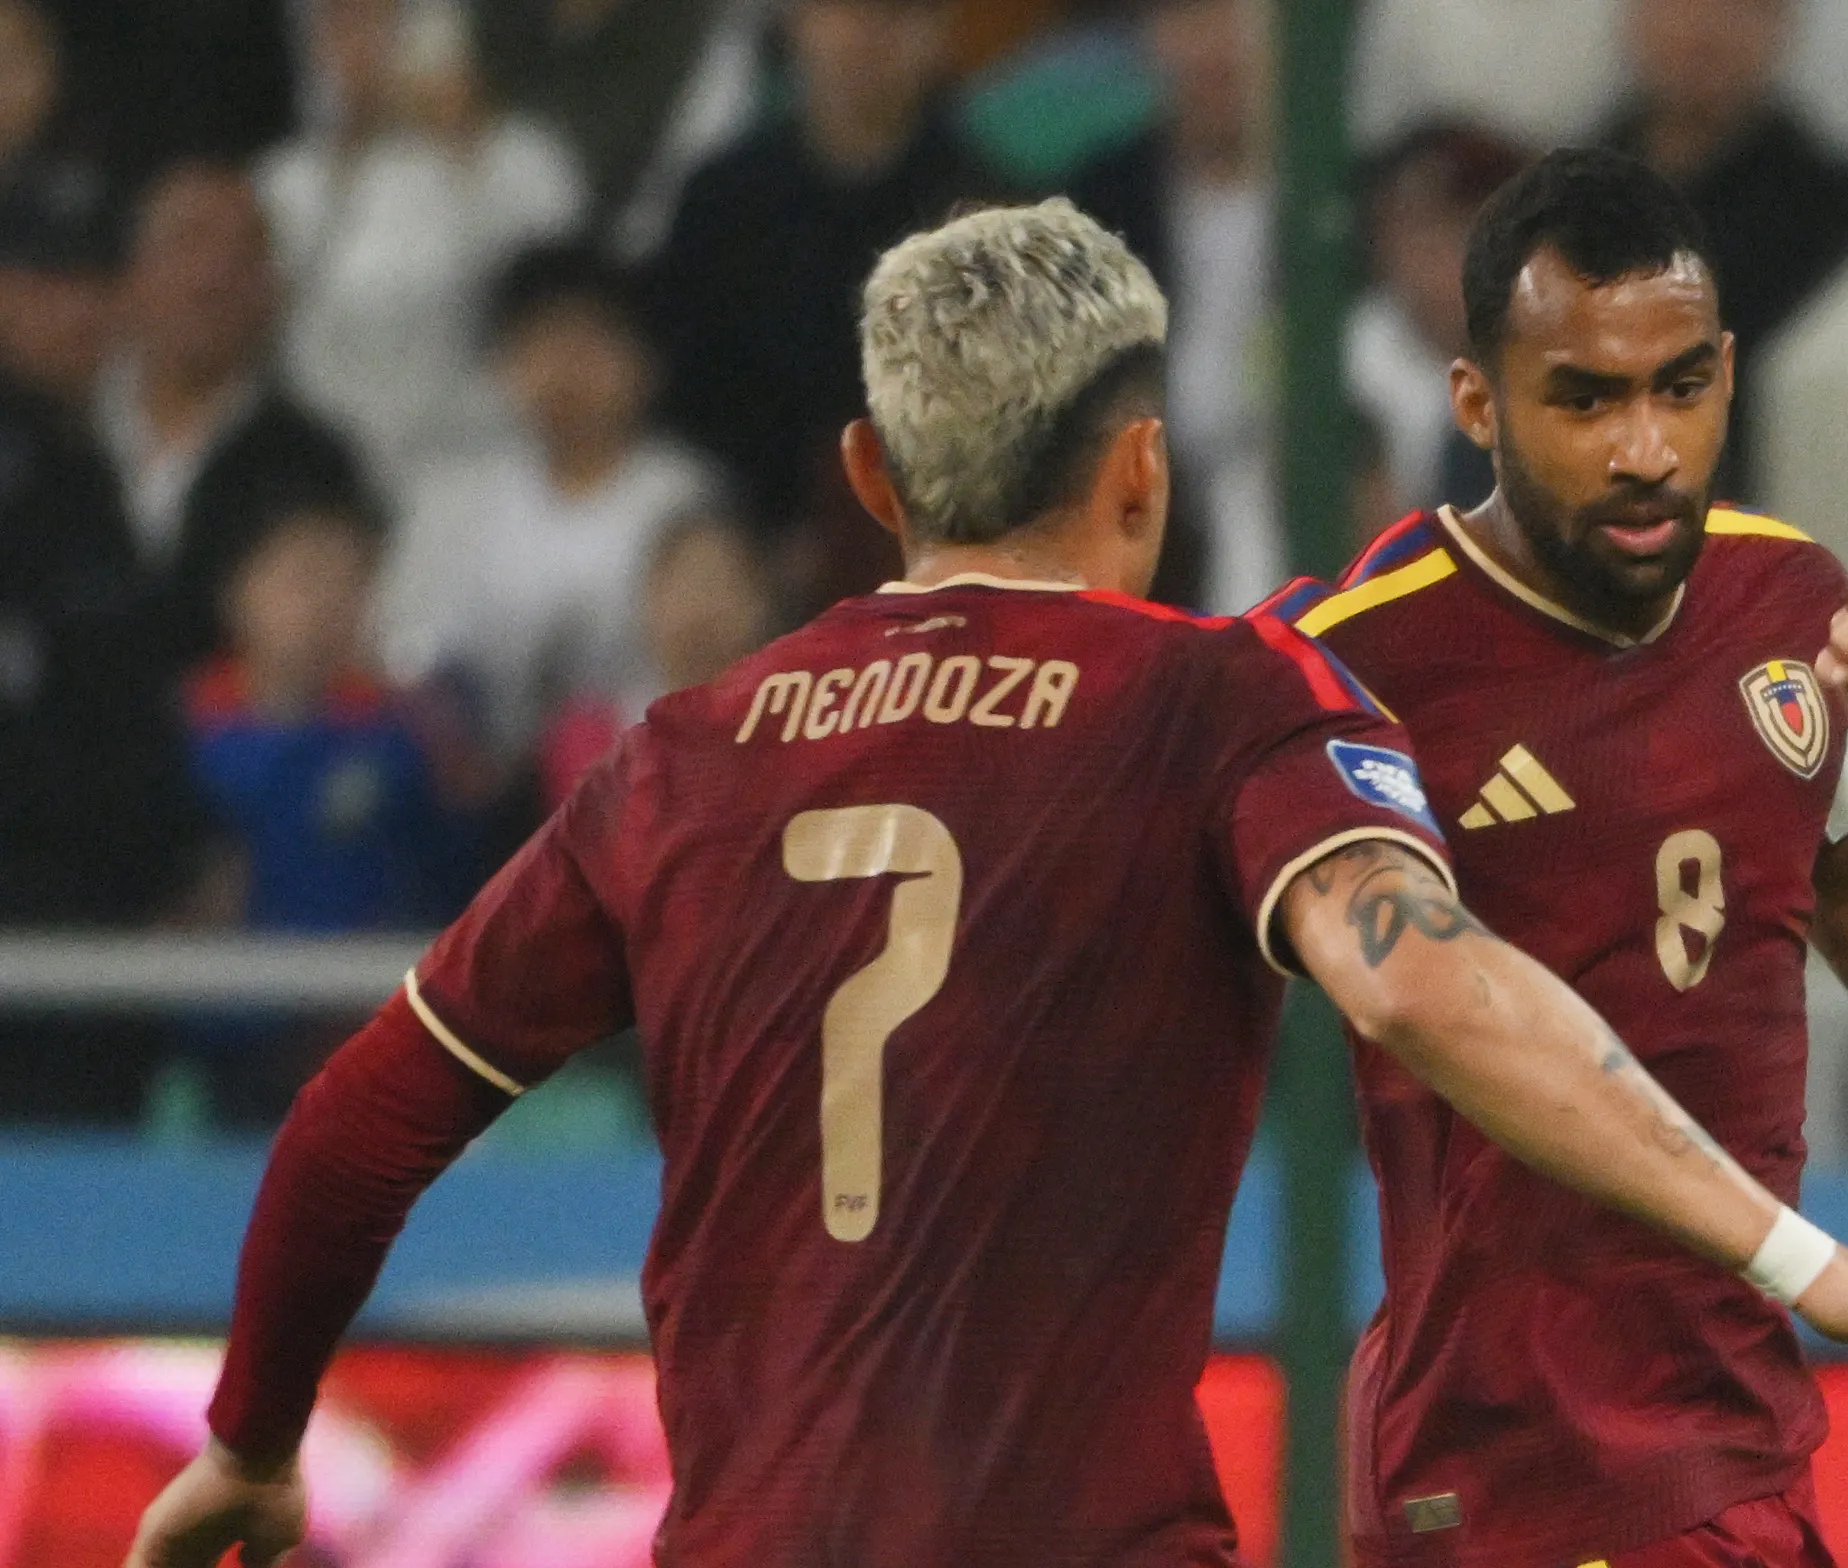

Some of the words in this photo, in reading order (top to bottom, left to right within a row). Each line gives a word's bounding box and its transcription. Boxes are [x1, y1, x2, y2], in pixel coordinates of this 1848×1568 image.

[735, 652, 1080, 744] MENDOZA
[1655, 828, 1726, 993] 8
[782, 803, 963, 1243] 7
